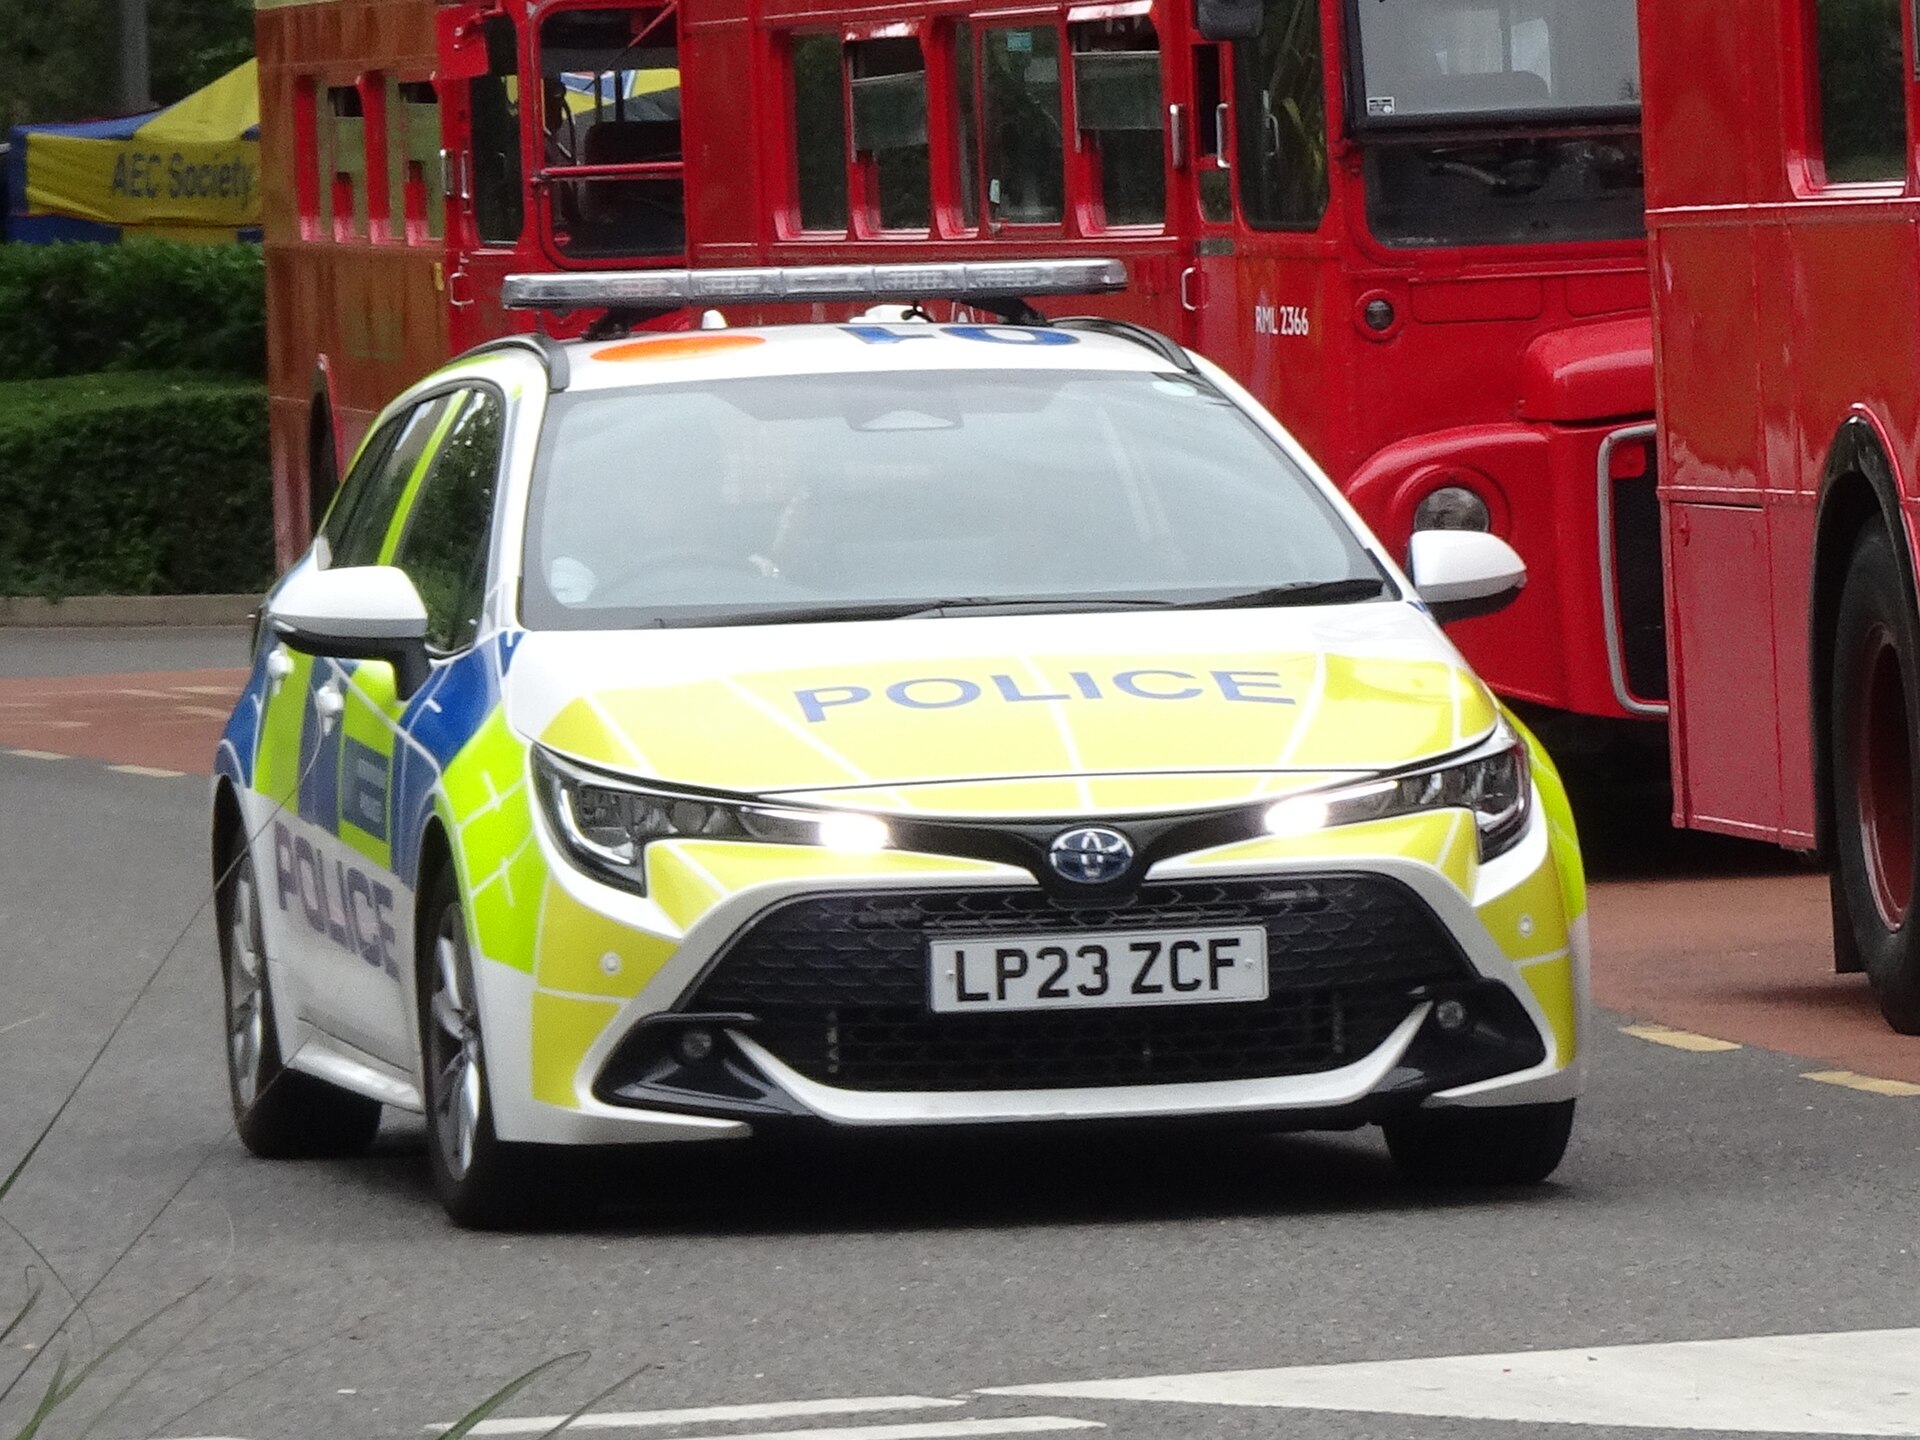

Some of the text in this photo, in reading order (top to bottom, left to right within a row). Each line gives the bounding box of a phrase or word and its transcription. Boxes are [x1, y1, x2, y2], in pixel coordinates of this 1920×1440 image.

[112, 152, 252, 210] AEC Society
[1255, 305, 1309, 336] RML 2366
[793, 669, 1296, 723] POLICE
[275, 820, 400, 982] POLICE
[955, 937, 1241, 1002] LP23 ZCF
